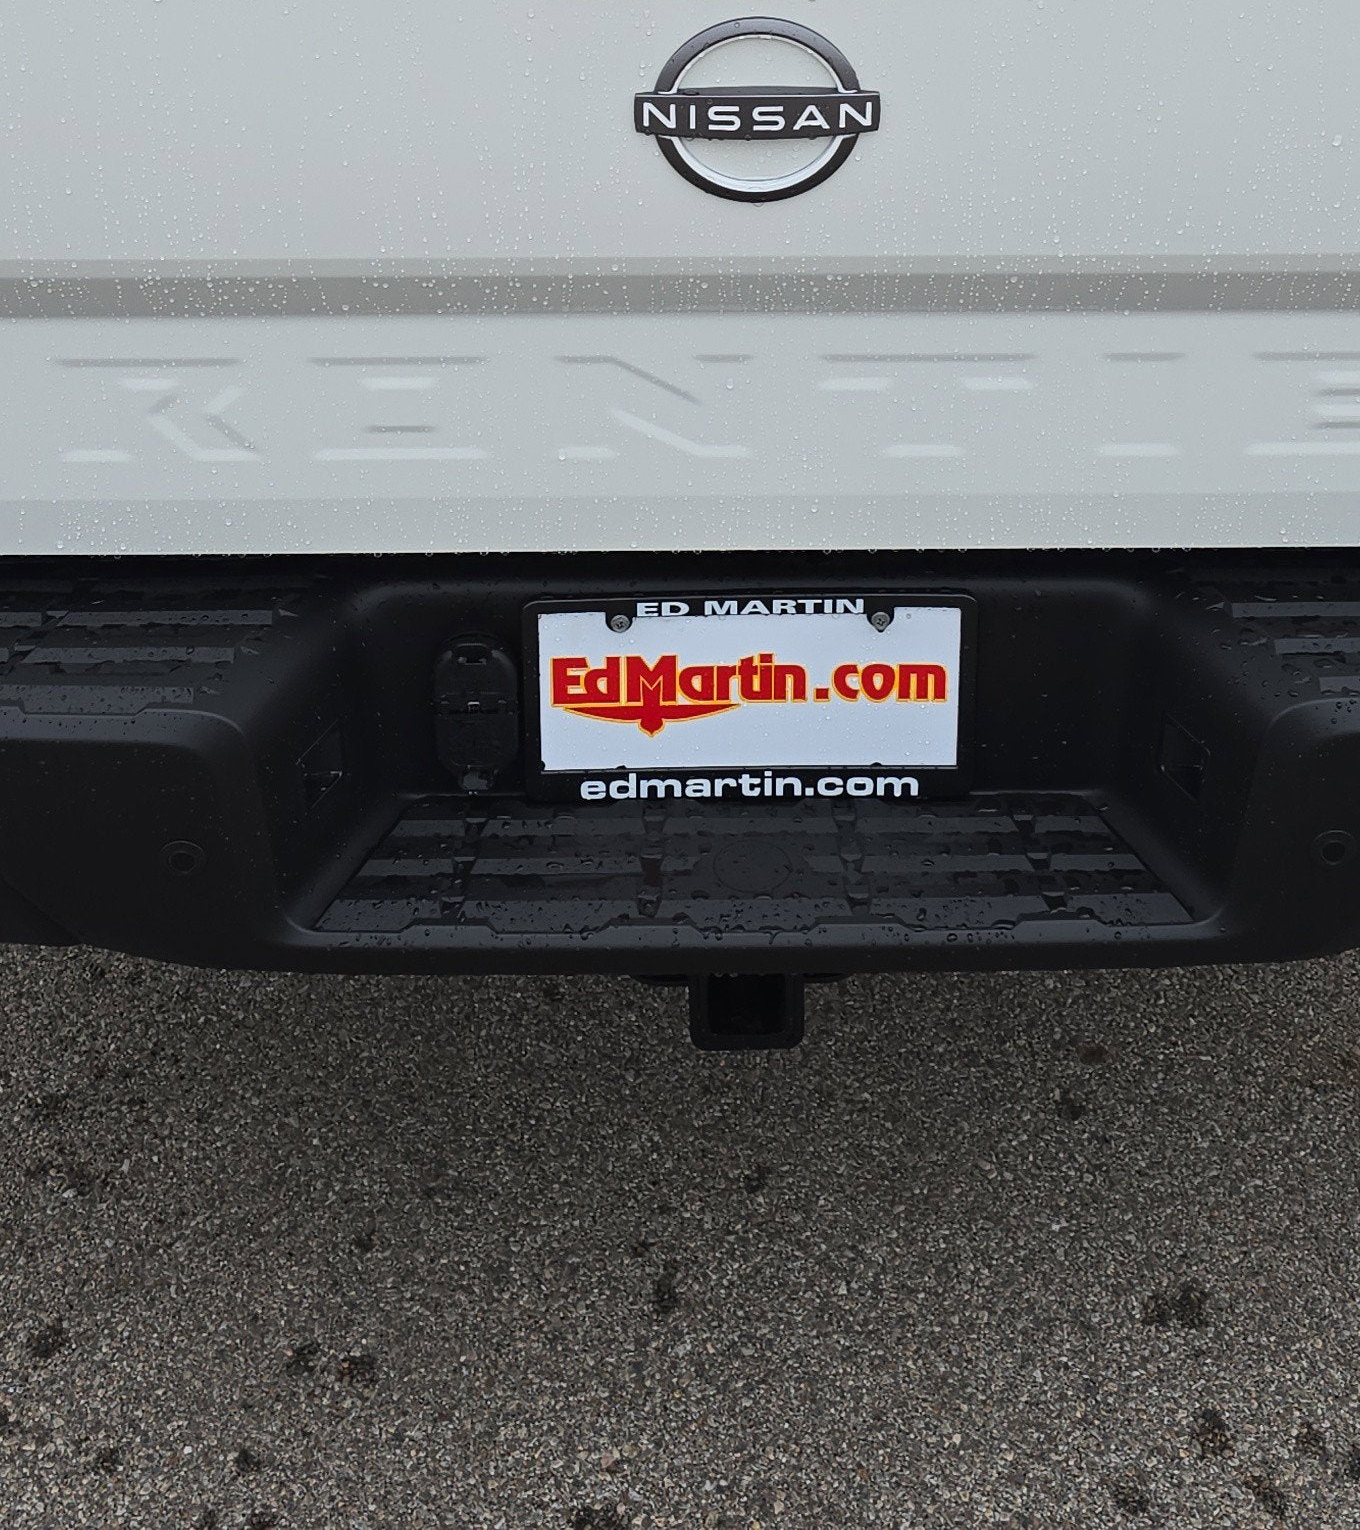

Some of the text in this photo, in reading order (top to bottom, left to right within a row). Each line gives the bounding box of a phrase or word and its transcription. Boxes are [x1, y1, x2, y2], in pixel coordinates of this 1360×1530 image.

[642, 101, 873, 131] NISSAN
[636, 598, 865, 618] ED MARTIN
[550, 653, 947, 708] EdMartin.com
[580, 771, 920, 801] edmartin.com
